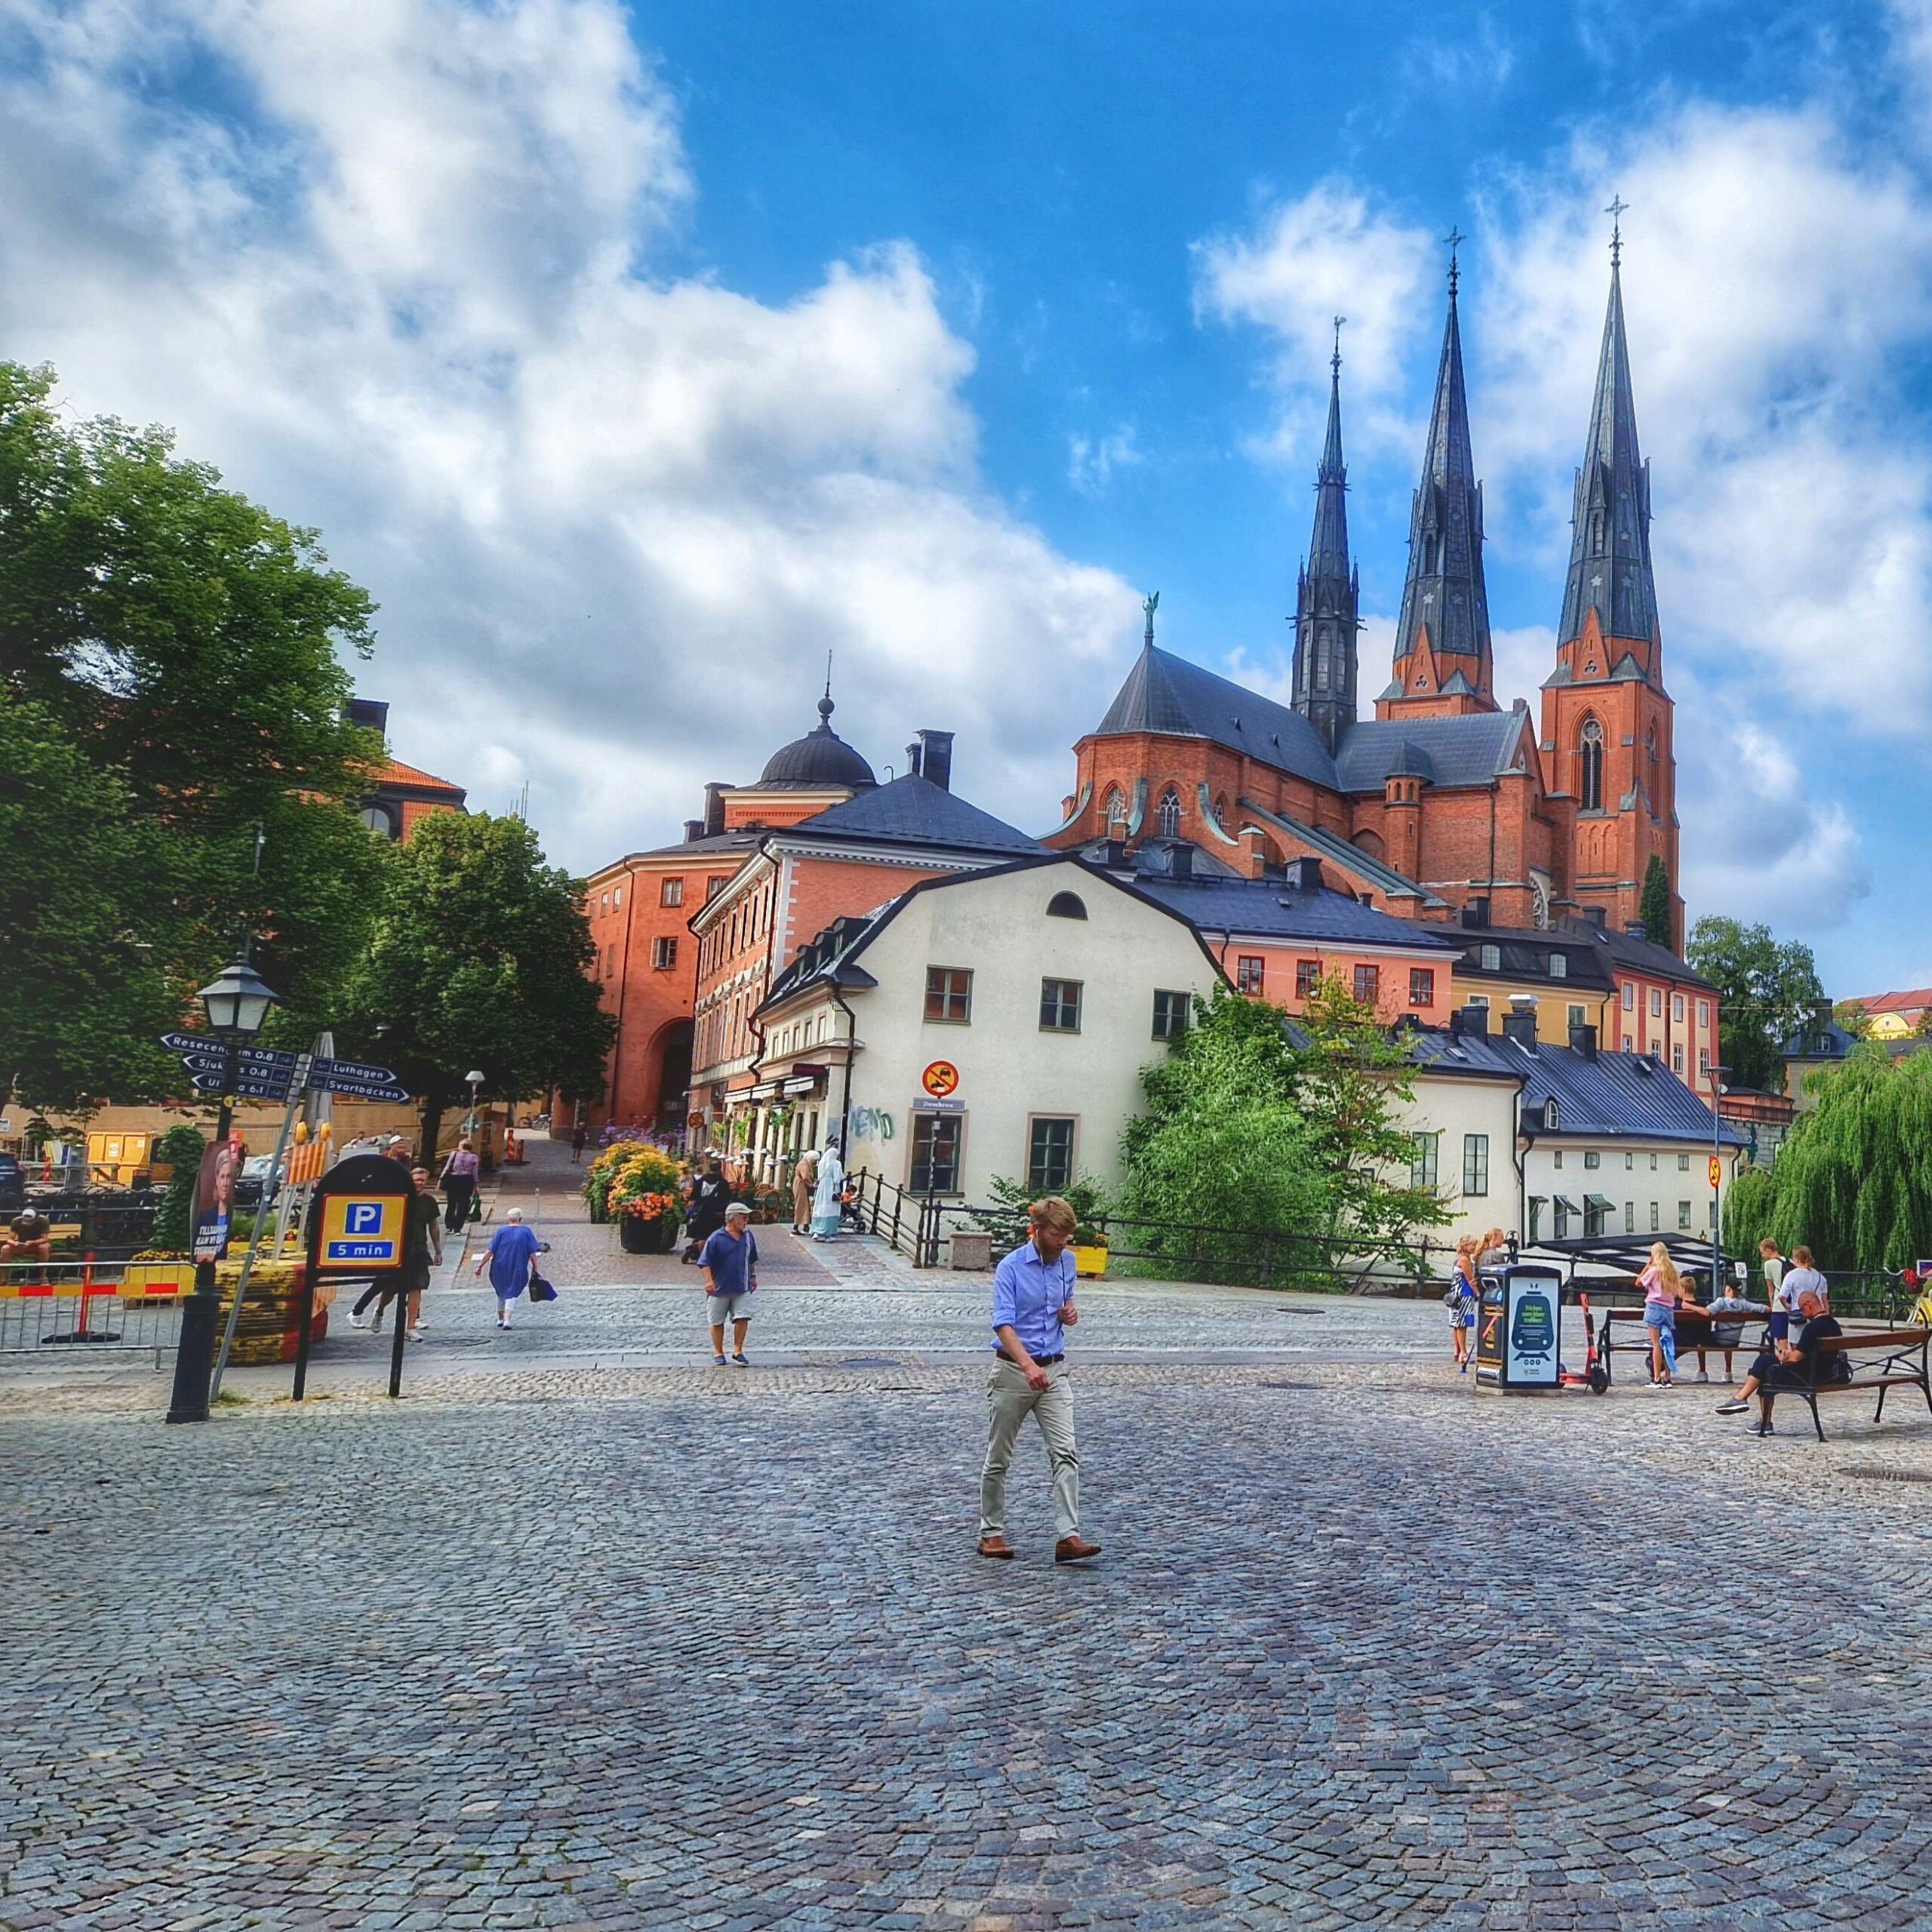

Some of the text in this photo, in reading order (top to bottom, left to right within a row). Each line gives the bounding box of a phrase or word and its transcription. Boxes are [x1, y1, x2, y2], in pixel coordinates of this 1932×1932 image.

[173, 1036, 273, 1061] Resecenm 0.8
[199, 1059, 268, 1077] Sjuks 0.8
[249, 1084, 263, 1094] 6.1
[329, 1080, 398, 1099] Svartbäcken
[354, 1206, 376, 1231] P
[337, 1244, 383, 1255] 5 min
